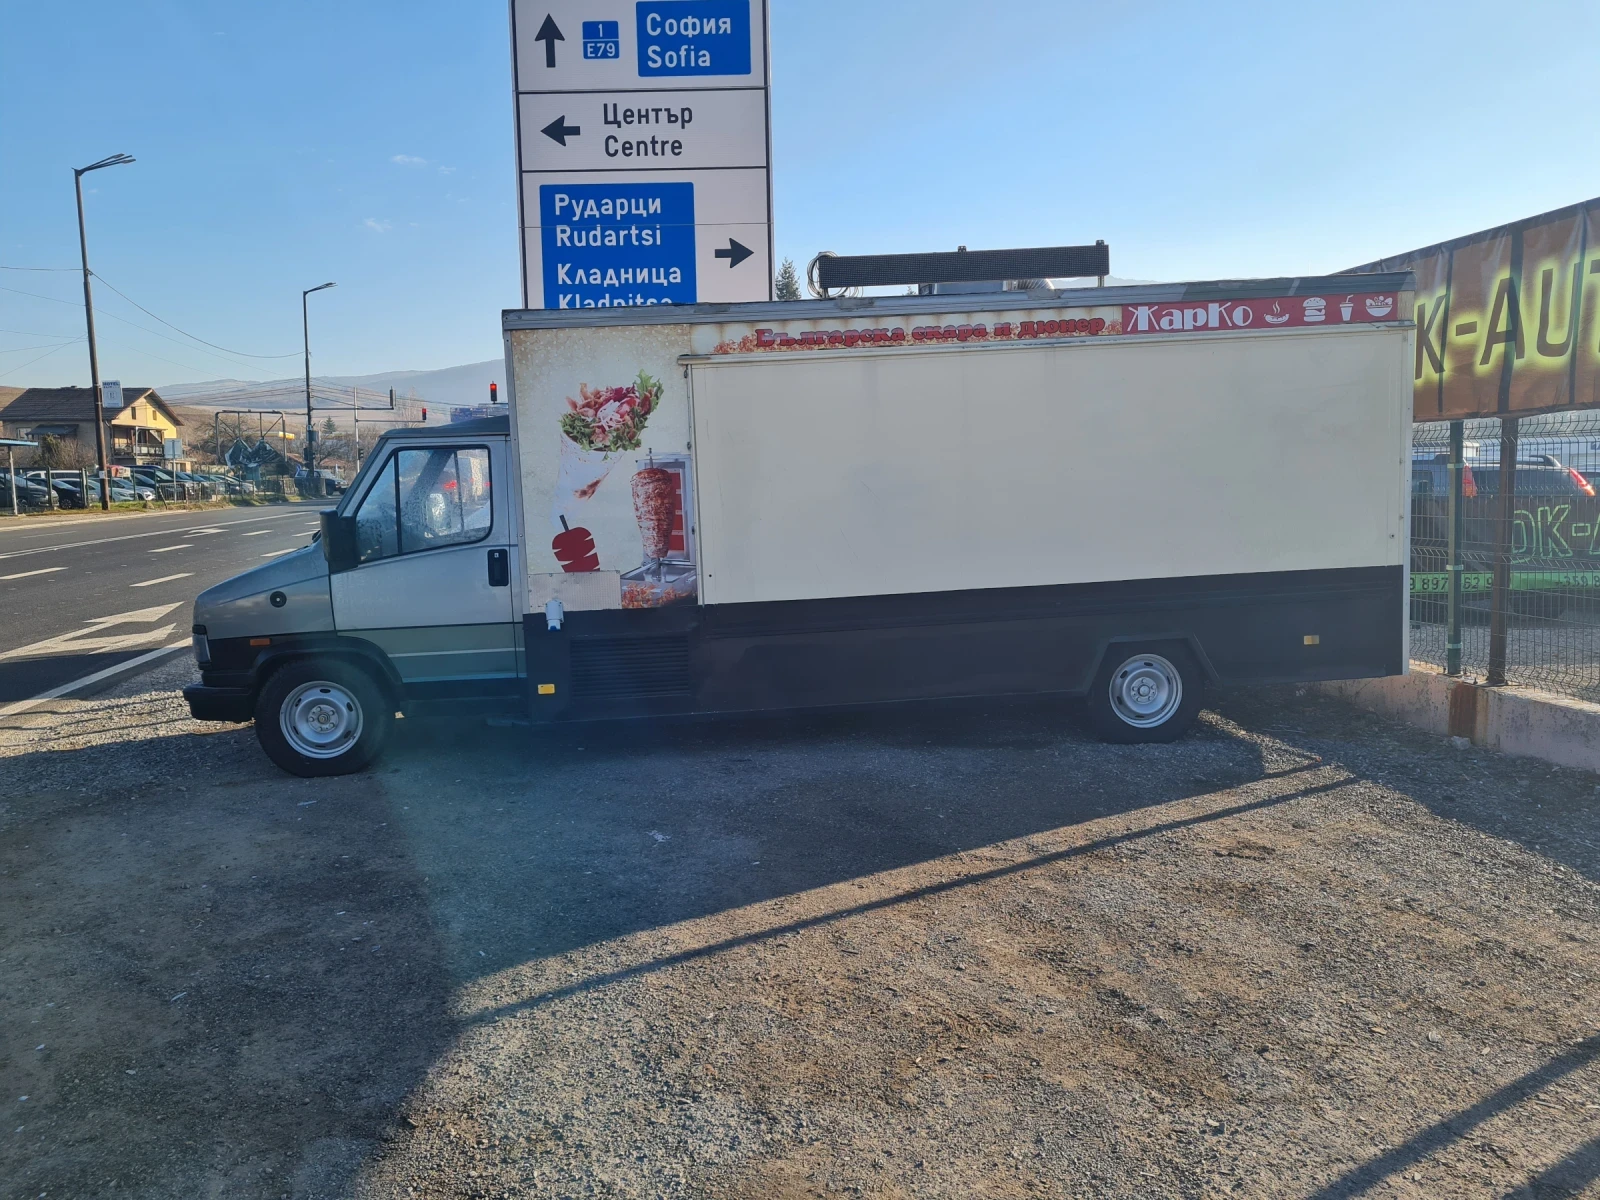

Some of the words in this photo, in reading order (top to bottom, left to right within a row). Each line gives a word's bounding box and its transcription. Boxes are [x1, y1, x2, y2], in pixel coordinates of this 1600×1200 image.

[597, 24, 603, 37] 1
[646, 13, 731, 37] София
[586, 42, 616, 57] E79
[647, 45, 711, 69] Sofia
[603, 102, 693, 129] Център
[604, 135, 683, 157] Centre
[554, 194, 662, 221] Рударци
[556, 225, 661, 247] Rudartsi
[557, 263, 682, 287] Кладница
[755, 327, 906, 348] Българска
[912, 322, 988, 342] скара
[994, 322, 1012, 337] и
[1017, 317, 1106, 339] дюнер
[1421, 577, 1449, 591] 897
